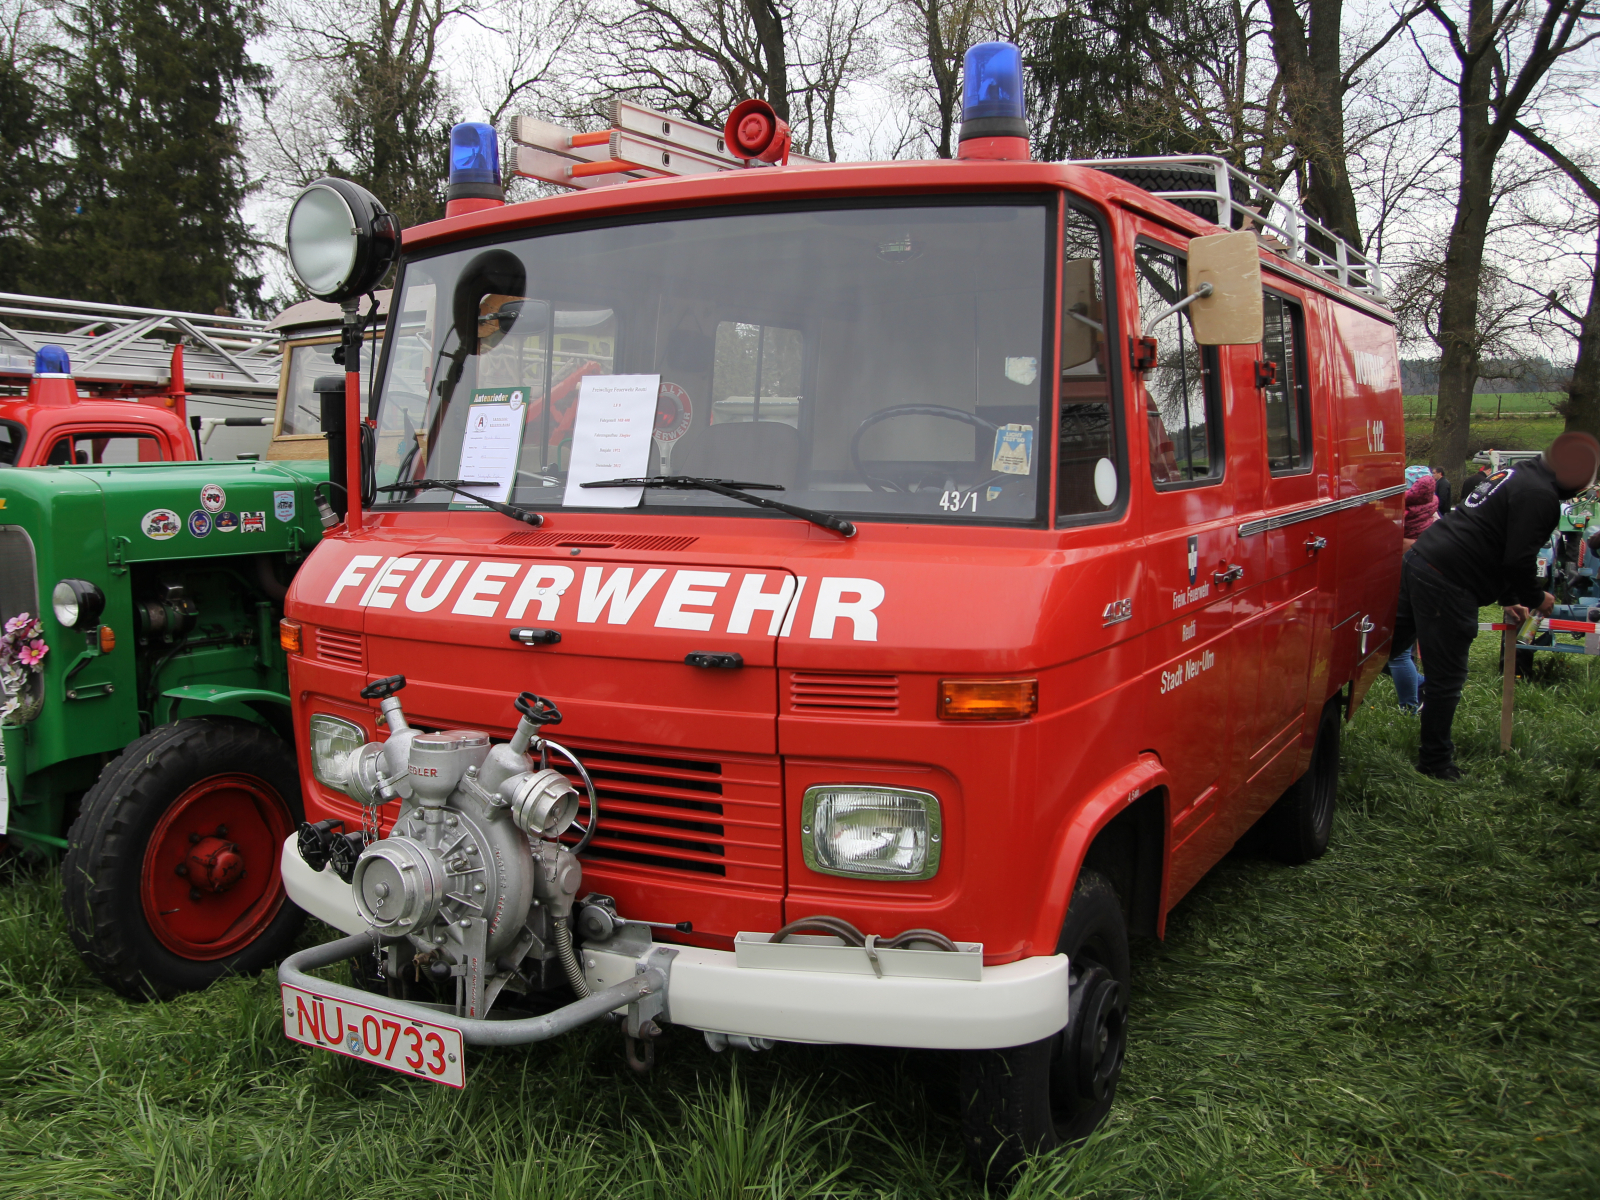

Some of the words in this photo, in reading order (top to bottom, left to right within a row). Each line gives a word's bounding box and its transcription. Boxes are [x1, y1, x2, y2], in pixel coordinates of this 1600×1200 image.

[473, 392, 509, 403] Autenrieder
[654, 412, 691, 441] ERWEHR
[1373, 420, 1384, 453] 112
[939, 490, 978, 513] 43/1
[326, 555, 885, 642] FEUERWEHR
[1187, 580, 1209, 604] Feuerwehr
[1102, 598, 1132, 622] 408
[1160, 664, 1183, 695] Stadt
[1185, 649, 1215, 682] Neu-Ulm
[409, 764, 438, 778] EGLER
